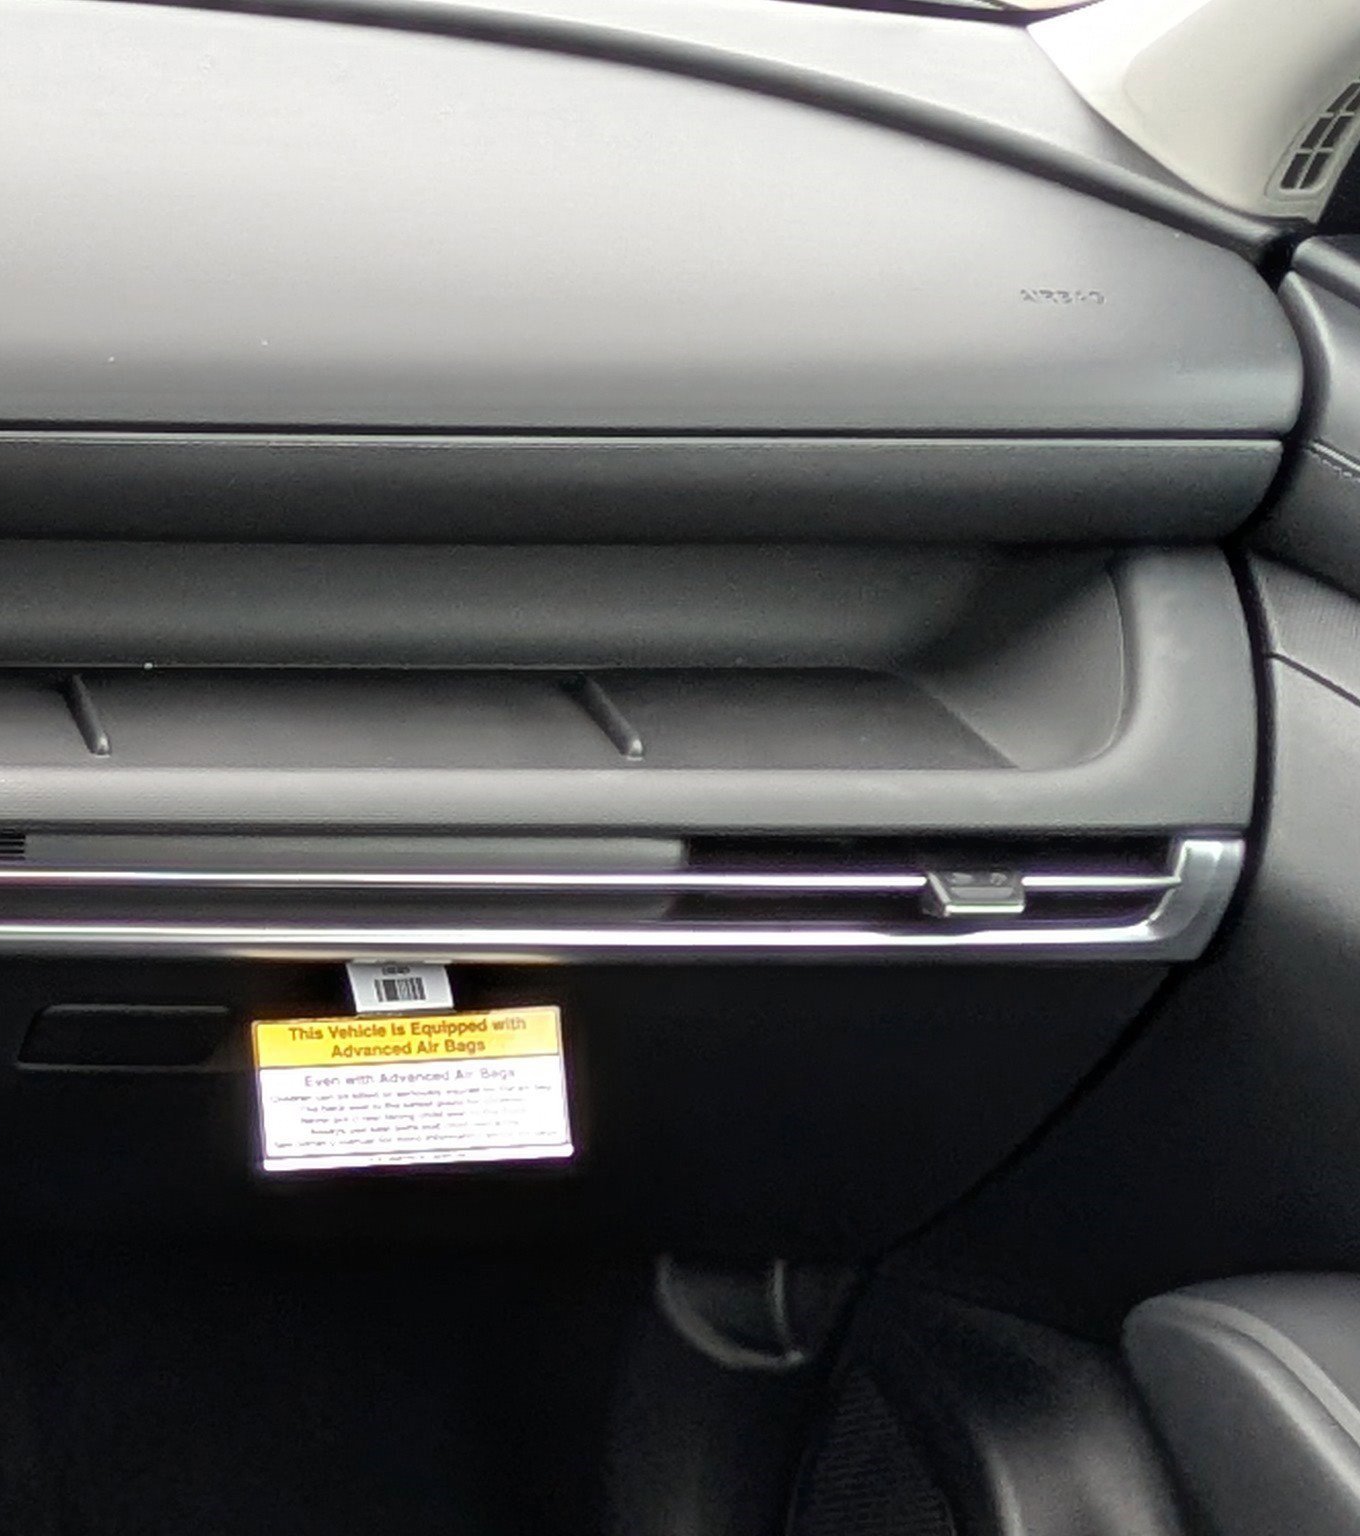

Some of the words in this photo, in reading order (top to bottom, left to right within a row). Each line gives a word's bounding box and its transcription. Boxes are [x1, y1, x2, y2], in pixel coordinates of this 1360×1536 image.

[289, 1026, 323, 1041] This
[327, 1023, 386, 1040] Vehicle
[410, 1018, 488, 1040] Equipped
[492, 1016, 527, 1032] with
[331, 1042, 411, 1058] Advanced
[417, 1040, 440, 1054] Air
[445, 1039, 486, 1056] Bags
[304, 1074, 341, 1087] Even
[379, 1070, 450, 1084] Advanced
